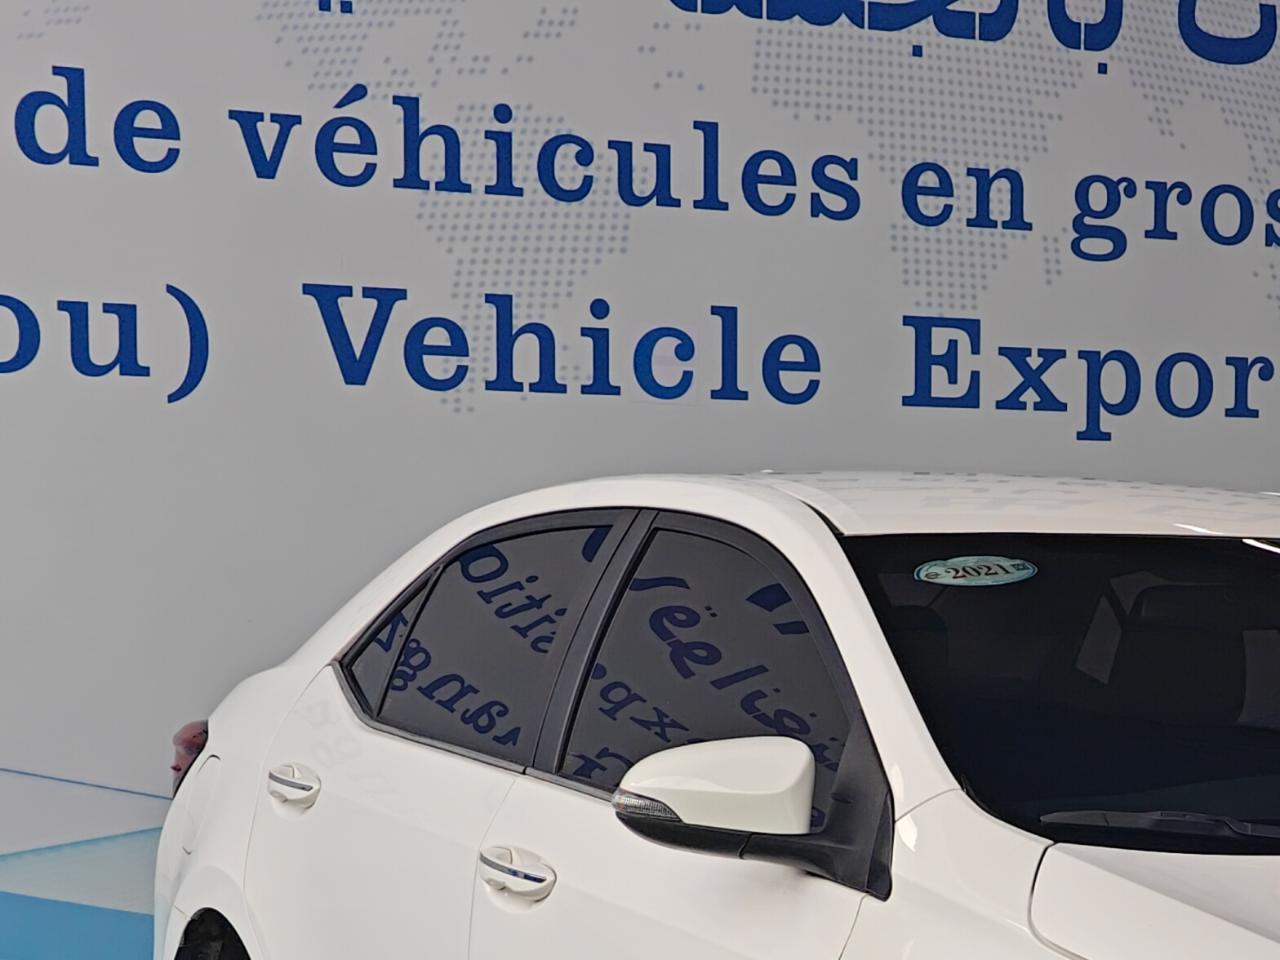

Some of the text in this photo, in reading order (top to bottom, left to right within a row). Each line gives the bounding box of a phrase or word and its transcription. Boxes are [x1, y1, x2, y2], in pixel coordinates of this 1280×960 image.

[14, 66, 181, 174] de
[228, 84, 862, 221] véhicules
[901, 161, 1032, 231] en
[302, 283, 822, 405] Vehicle
[945, 563, 1011, 580] 2021
